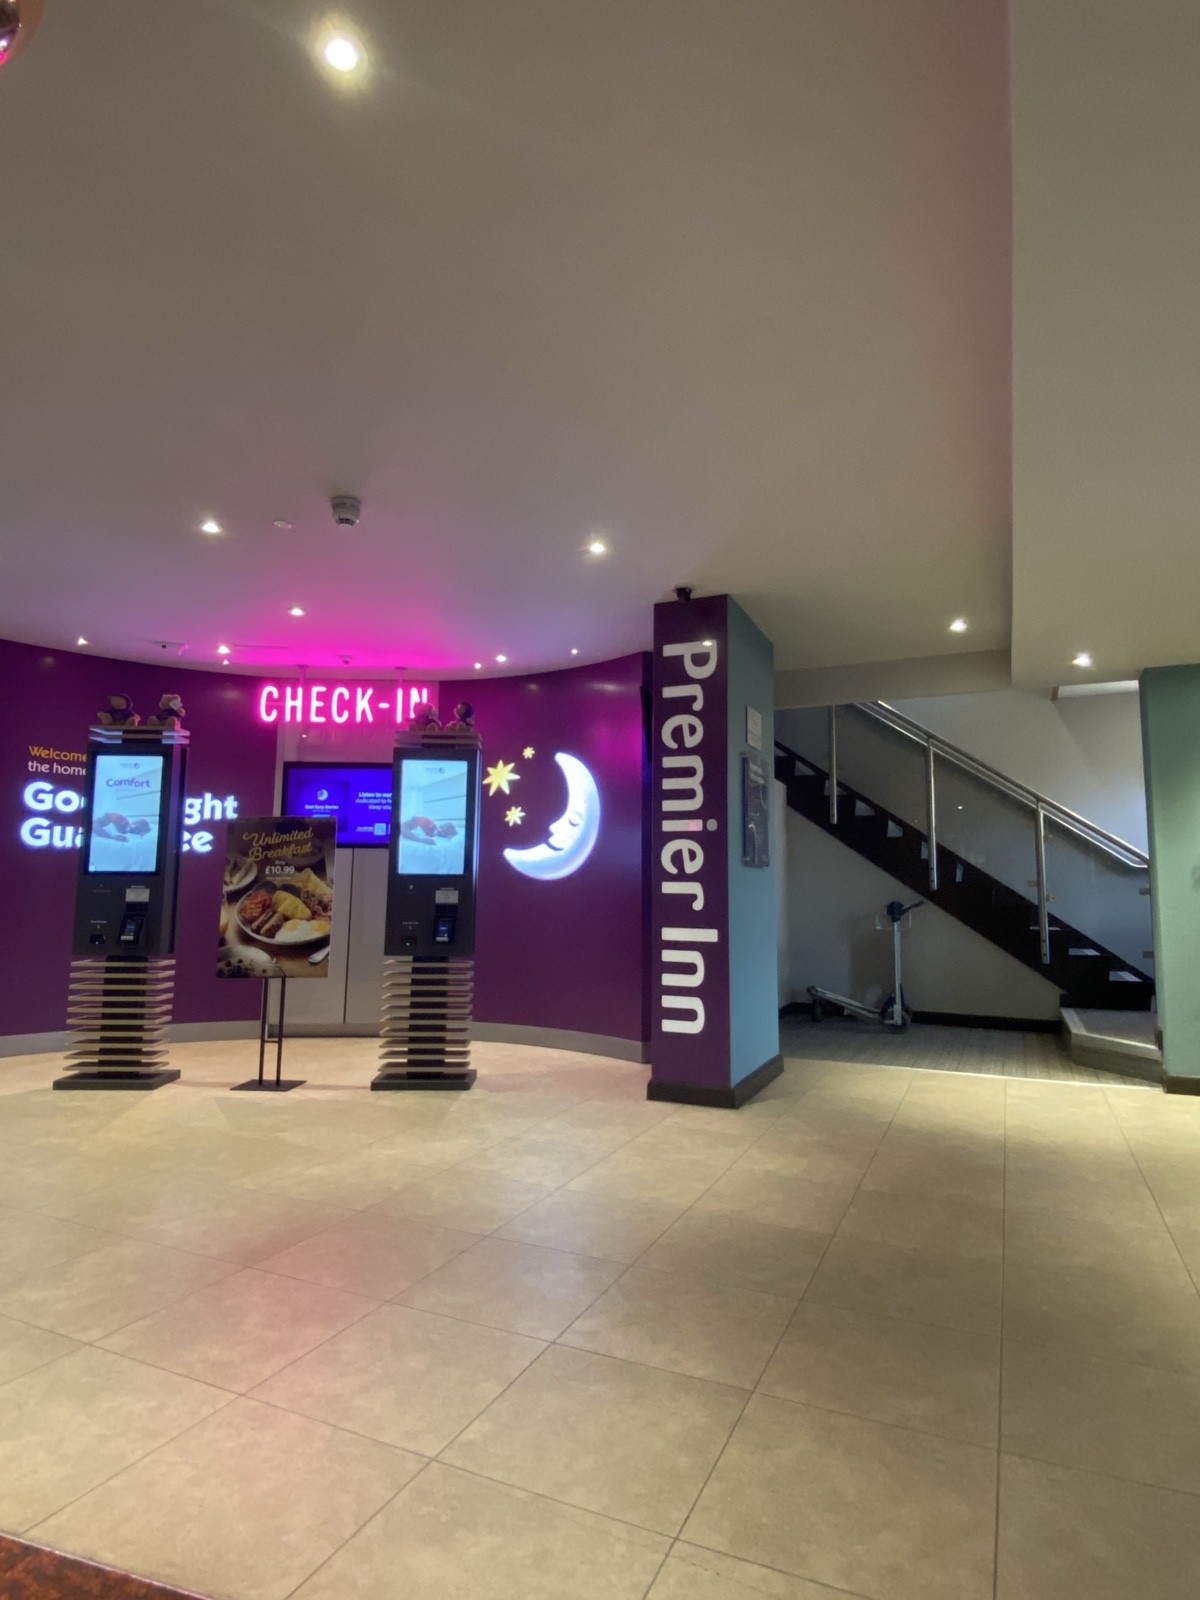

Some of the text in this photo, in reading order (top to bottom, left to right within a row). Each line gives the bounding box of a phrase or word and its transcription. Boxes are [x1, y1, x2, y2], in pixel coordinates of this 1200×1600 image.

[259, 685, 428, 724] CHECK-IN
[27, 760, 50, 773] the
[105, 777, 151, 788] Comfort
[184, 791, 239, 826] ght
[242, 826, 314, 847] Unlimited
[660, 639, 719, 1035] Premier Inn
[246, 842, 313, 861] Breakfast
[265, 865, 295, 875] £10.99
